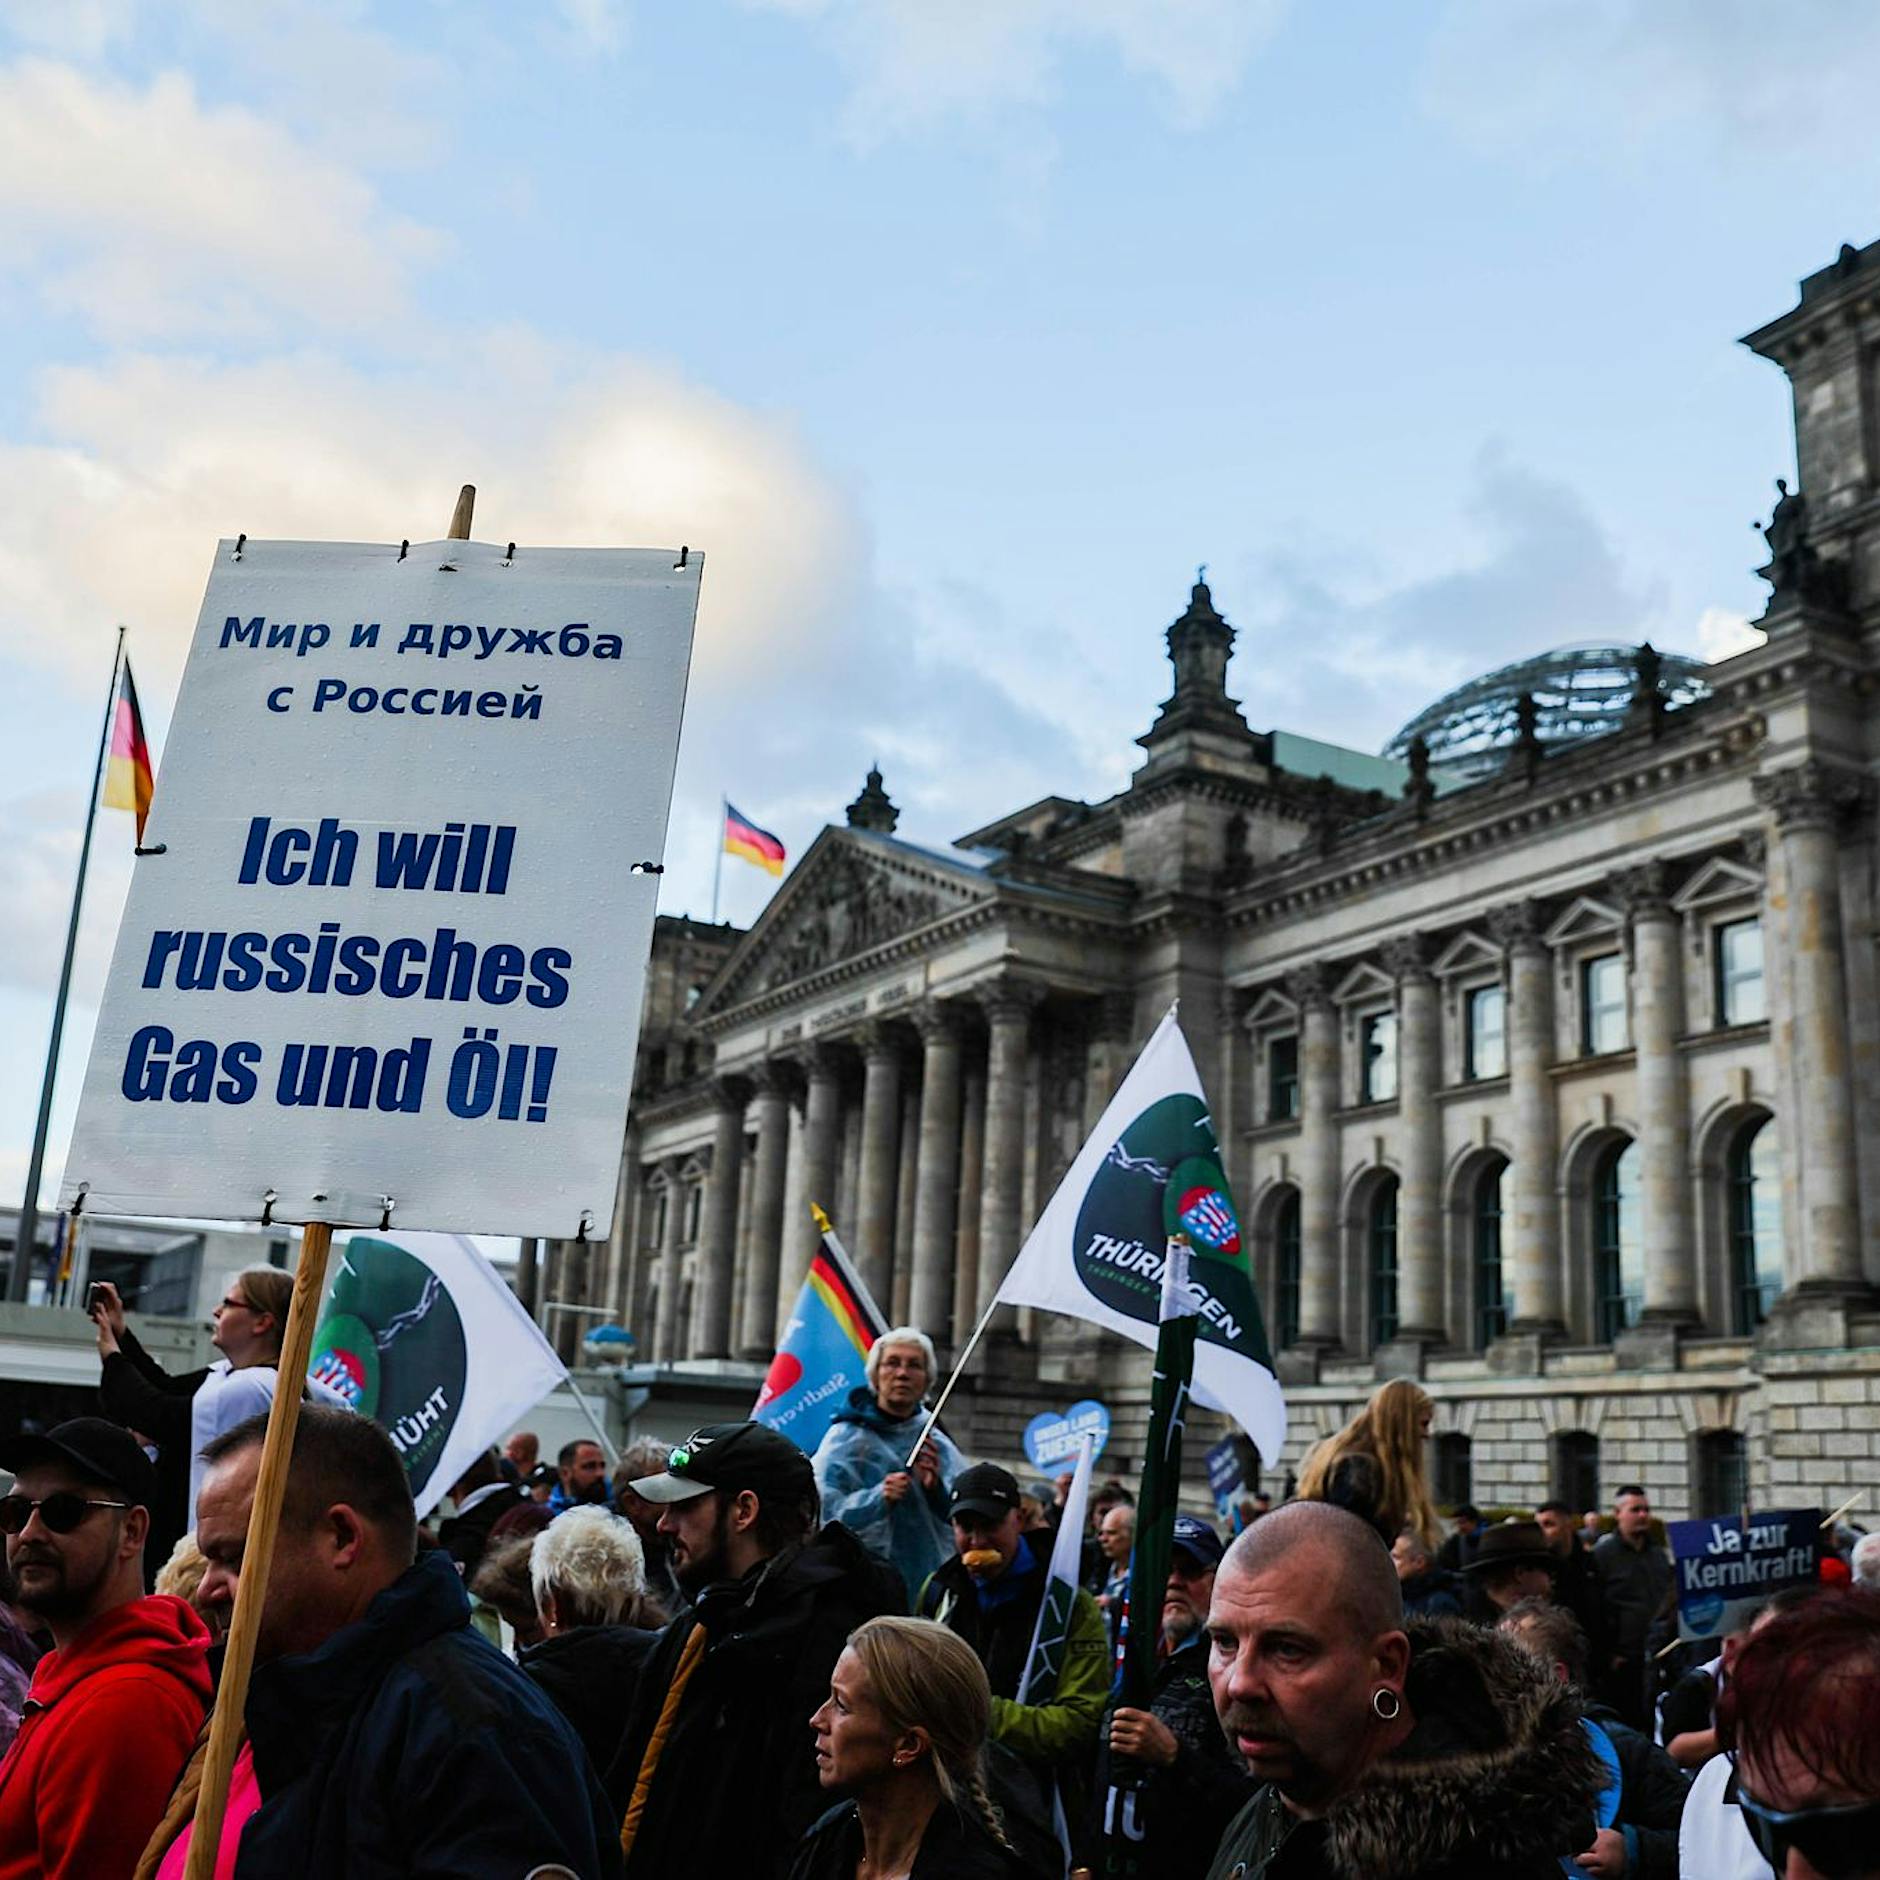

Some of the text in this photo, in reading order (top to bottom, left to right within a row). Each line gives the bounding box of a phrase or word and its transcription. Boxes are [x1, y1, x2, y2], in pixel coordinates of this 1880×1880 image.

[219, 616, 624, 660] Мир и дружба
[267, 678, 542, 720] с Россией
[238, 817, 516, 895] Ich will
[142, 923, 571, 1008] russisches
[122, 1026, 558, 1122] Gas und Öl!
[1707, 1523, 1789, 1554] Ja zur
[1683, 1545, 1813, 1590] Kernkraft!
